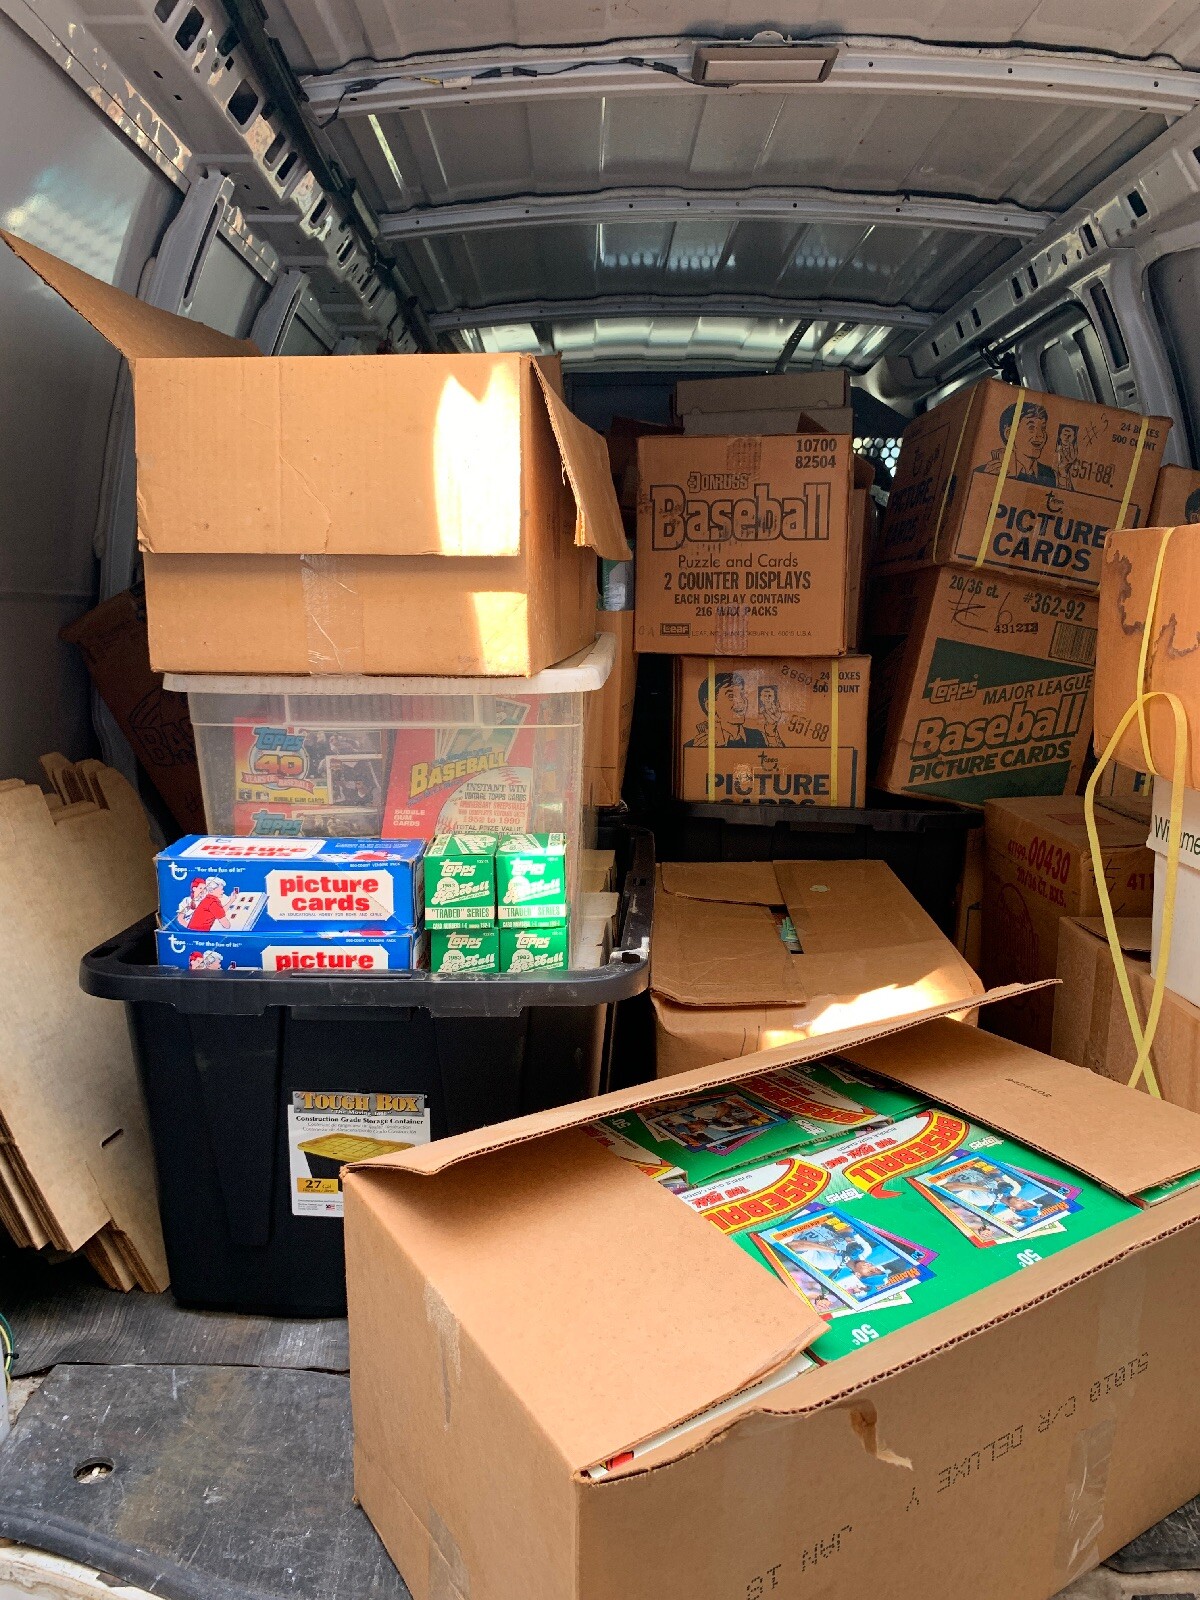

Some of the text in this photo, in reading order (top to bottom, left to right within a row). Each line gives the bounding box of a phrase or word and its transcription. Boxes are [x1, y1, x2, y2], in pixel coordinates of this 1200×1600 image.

[1111, 433, 1127, 445] 500
[1120, 422, 1161, 439] 24 BXES
[796, 438, 837, 453] 10700
[795, 454, 837, 469] 82504
[650, 482, 831, 551] Baseball
[988, 500, 1109, 550] PICTURE
[678, 552, 799, 569] Puzzle and Cards
[992, 532, 1092, 573] CARDS
[664, 571, 811, 591] 2 COUNTER DISPLAYS
[948, 574, 983, 596] 20/36
[674, 593, 801, 605] EACH DISPLAY CONTAINS
[1023, 591, 1087, 622] #362-92
[695, 606, 713, 617] 216
[744, 605, 778, 617] PACKS
[662, 624, 690, 635] Leaf
[820, 672, 831, 681] 24
[834, 671, 861, 681] OXES
[813, 684, 860, 694] 500 OUNT
[982, 684, 1034, 706] MAJOR
[1036, 673, 1094, 697] LEAGUE
[910, 691, 1089, 762] Baseball
[254, 753, 305, 779] 40
[908, 740, 1072, 784] PICTURE CARDS
[409, 751, 510, 800] BASEBALL
[705, 773, 830, 796] PICTURE
[466, 782, 528, 793] INSTANT WIN
[488, 792, 506, 801] TOPPS
[508, 793, 527, 802] CARDS
[394, 809, 427, 817] BUBBLE
[394, 814, 413, 822] GUM
[393, 819, 421, 828] CARDS
[1028, 836, 1071, 885] 00430
[279, 874, 380, 896] picture
[291, 894, 371, 912] cards
[537, 906, 561, 917] SERIES
[466, 907, 491, 919] SERIES
[275, 951, 374, 971] picture
[301, 1092, 419, 1113] TOUGH BOX
[295, 1115, 339, 1123] Construction
[340, 1116, 362, 1124] Grade
[362, 1117, 389, 1125] Storage
[850, 1116, 963, 1184] BASEBALL
[305, 1179, 322, 1189] 27
[706, 1162, 824, 1231] BASEBAL
[937, 1424, 1024, 1494] DELUXE
[801, 1524, 853, 1572] JAN
